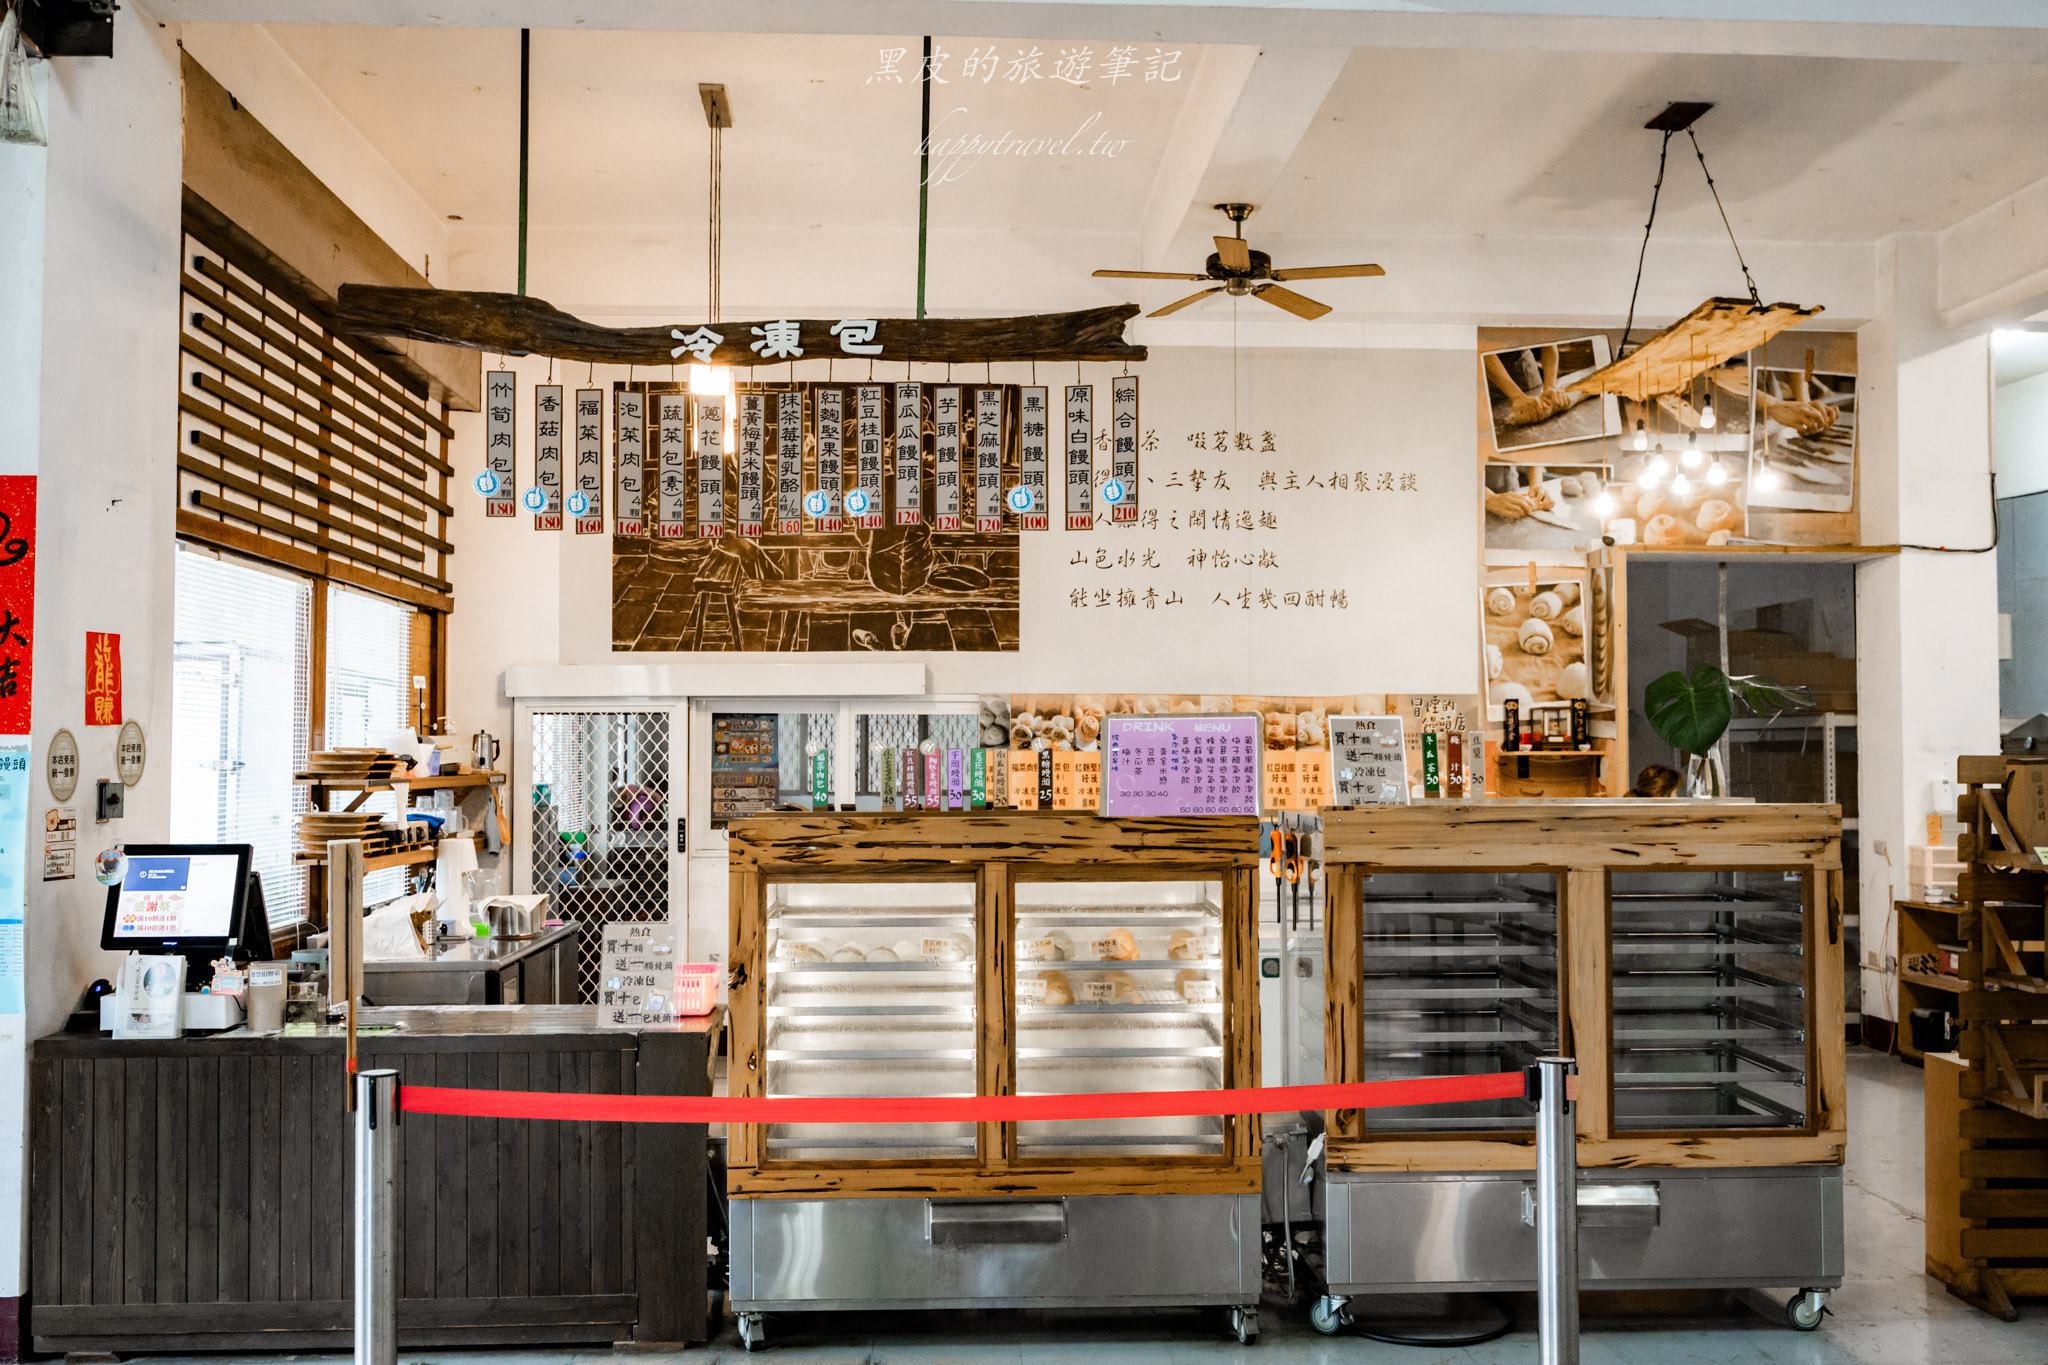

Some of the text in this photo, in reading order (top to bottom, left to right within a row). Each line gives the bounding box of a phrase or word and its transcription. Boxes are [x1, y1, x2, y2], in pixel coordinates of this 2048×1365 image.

[670, 319, 883, 363] 冷凍包
[490, 383, 513, 472] 竹筍肉包
[897, 384, 919, 481] 南瓜瓜饅頭
[1115, 388, 1135, 477] 綜合饅頭
[538, 396, 560, 486] 香菇肉包
[820, 390, 840, 491] 紅麴堅果饅頭
[860, 388, 880, 488] 紅豆桂圓饅頭
[937, 398, 958, 487] 芋頭饅頭
[978, 391, 999, 488] 黑芝麻饅頭
[1023, 397, 1045, 487] 黑糖饅頭
[1068, 388, 1089, 485] 原味白饅頭
[579, 400, 599, 490] 福菜肉包
[620, 402, 641, 492] 泡菜肉包
[780, 393, 800, 493] 抹茶莓莓乳酪
[661, 405, 682, 496] 蔬菜包(素)
[490, 502, 513, 515] 180
[1115, 508, 1136, 520] 210
[538, 516, 560, 528] 180
[860, 515, 882, 528] 140
[897, 511, 919, 523] 120
[938, 517, 959, 529] 120
[1023, 516, 1046, 529] 100
[1069, 515, 1091, 528] 100
[579, 520, 600, 533] 160
[618, 522, 641, 534] 160
[660, 524, 682, 536] 160
[700, 525, 722, 537] 120
[739, 524, 762, 535] 140
[779, 520, 800, 533] 160
[820, 519, 841, 531] 140
[978, 519, 1000, 531] 120
[1070, 547, 1161, 569] 山色水光
[1123, 721, 1231, 732] DRINK MENU
[121, 743, 141, 753] 本店使用
[52, 755, 75, 765] 本店使用
[1075, 763, 1100, 772] 紅麴堅
[1355, 767, 1386, 777] 冷凍包
[1426, 773, 1438, 785] 30
[1450, 773, 1462, 785] 30
[1472, 773, 1484, 784] 30
[724, 789, 736, 798] 60
[814, 791, 827, 802] 40
[950, 789, 962, 800] 30
[972, 790, 984, 800] 30
[1040, 789, 1052, 800] 25
[724, 803, 736, 811] 50
[904, 795, 917, 808] 35
[927, 795, 940, 808] 35
[622, 975, 655, 986] 冷凍包
